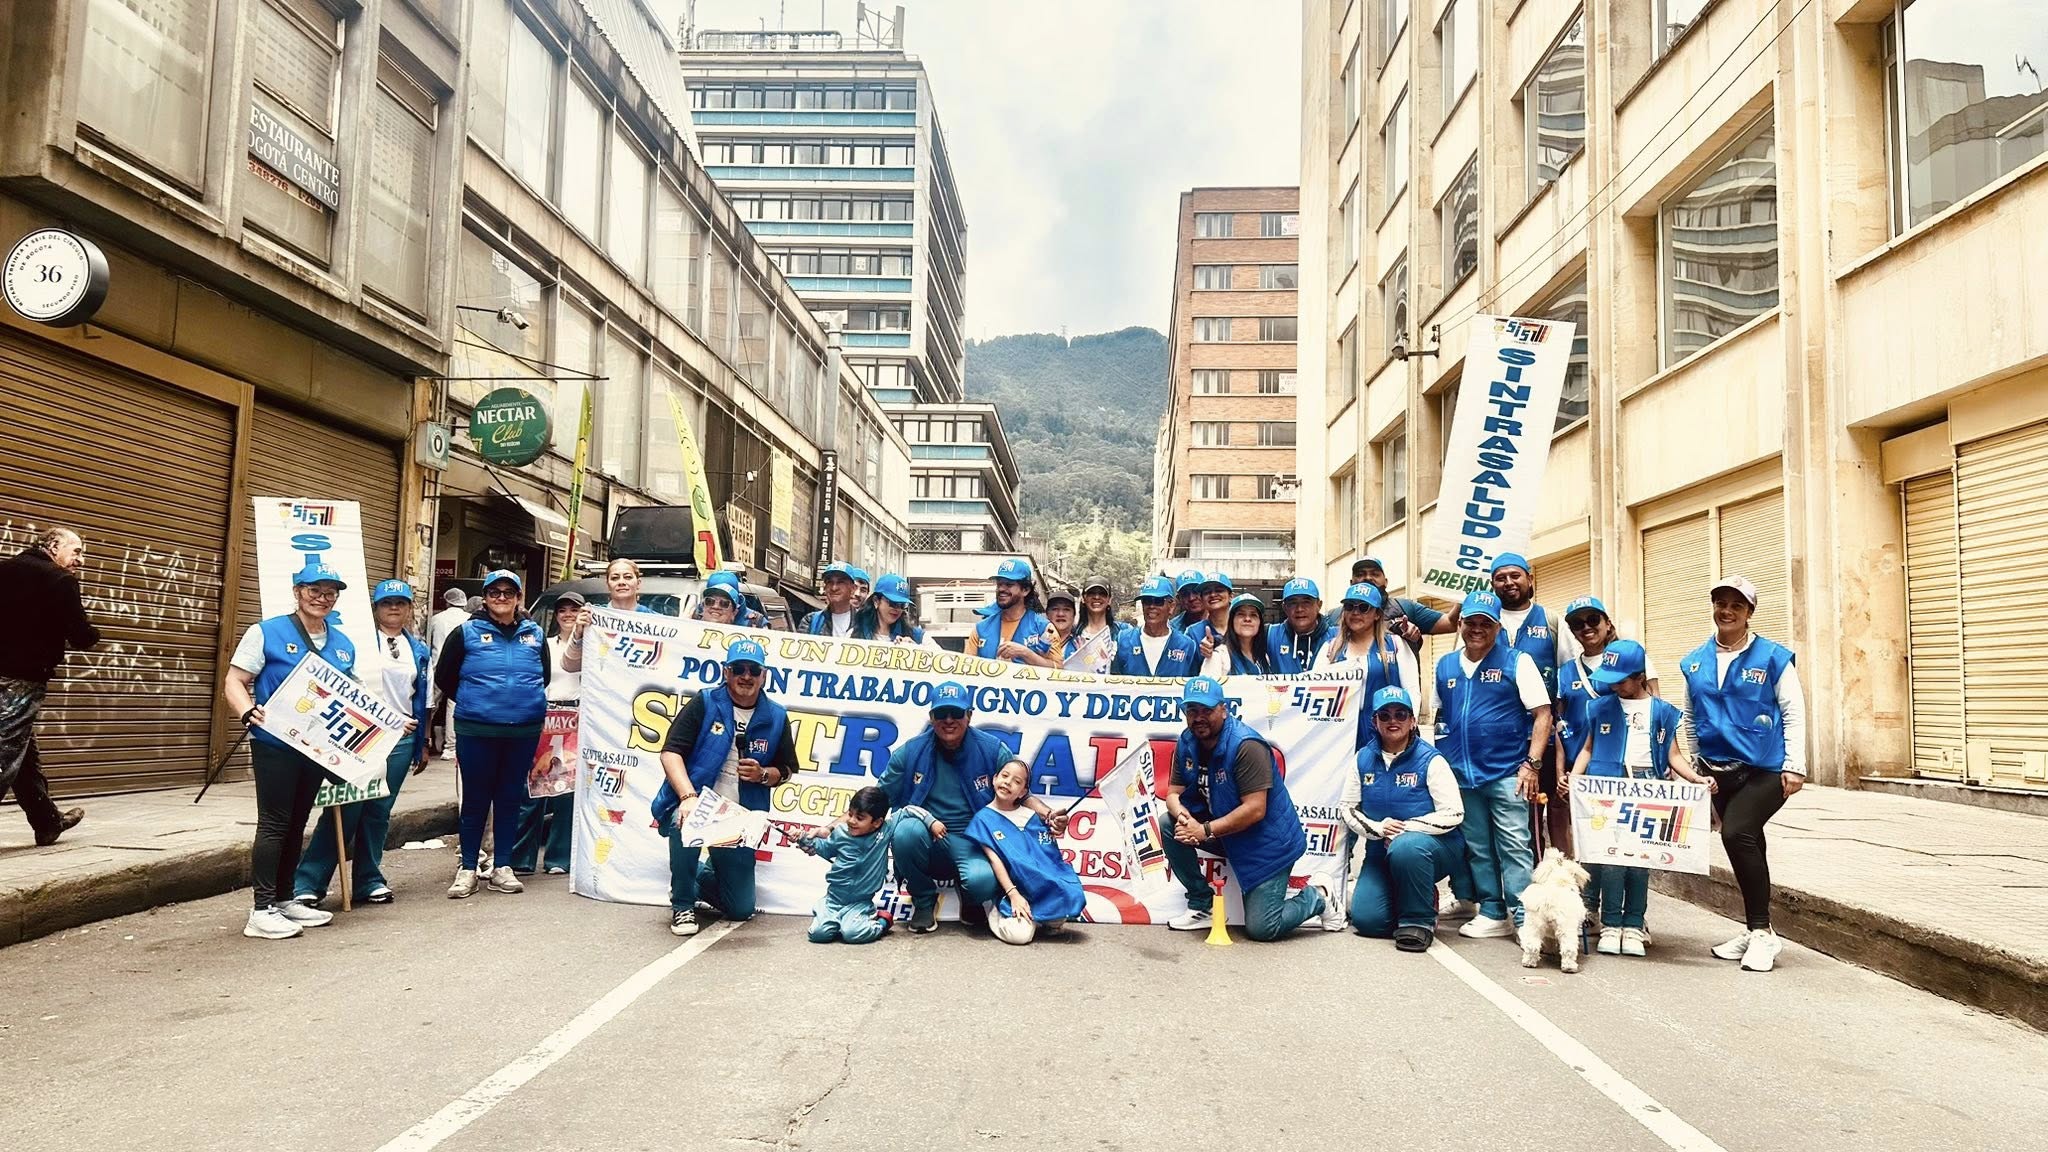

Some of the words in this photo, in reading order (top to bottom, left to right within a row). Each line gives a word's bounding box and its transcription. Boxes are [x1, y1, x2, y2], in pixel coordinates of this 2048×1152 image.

[250, 105, 340, 187] ESTAURANTE
[248, 129, 288, 172] OGOTÁ
[294, 163, 338, 206] CENTRO
[33, 264, 63, 283] 36
[477, 406, 536, 424] NECTAR
[1461, 348, 1536, 539] SINTRASALUD
[1423, 568, 1494, 595] PRESEN
[591, 612, 678, 638] SINTRASALUD
[780, 638, 833, 663] UN
[835, 643, 1008, 677] DERECHO
[306, 661, 404, 730] SINTRASALUD
[678, 656, 727, 686] PO
[797, 670, 935, 707] TRABAJO
[965, 684, 1047, 716] IGNO
[1055, 691, 1080, 718] Y
[544, 716, 578, 730] MAYO
[314, 778, 382, 806] ESENE!
[1577, 778, 1705, 802] SINTRASALUD
